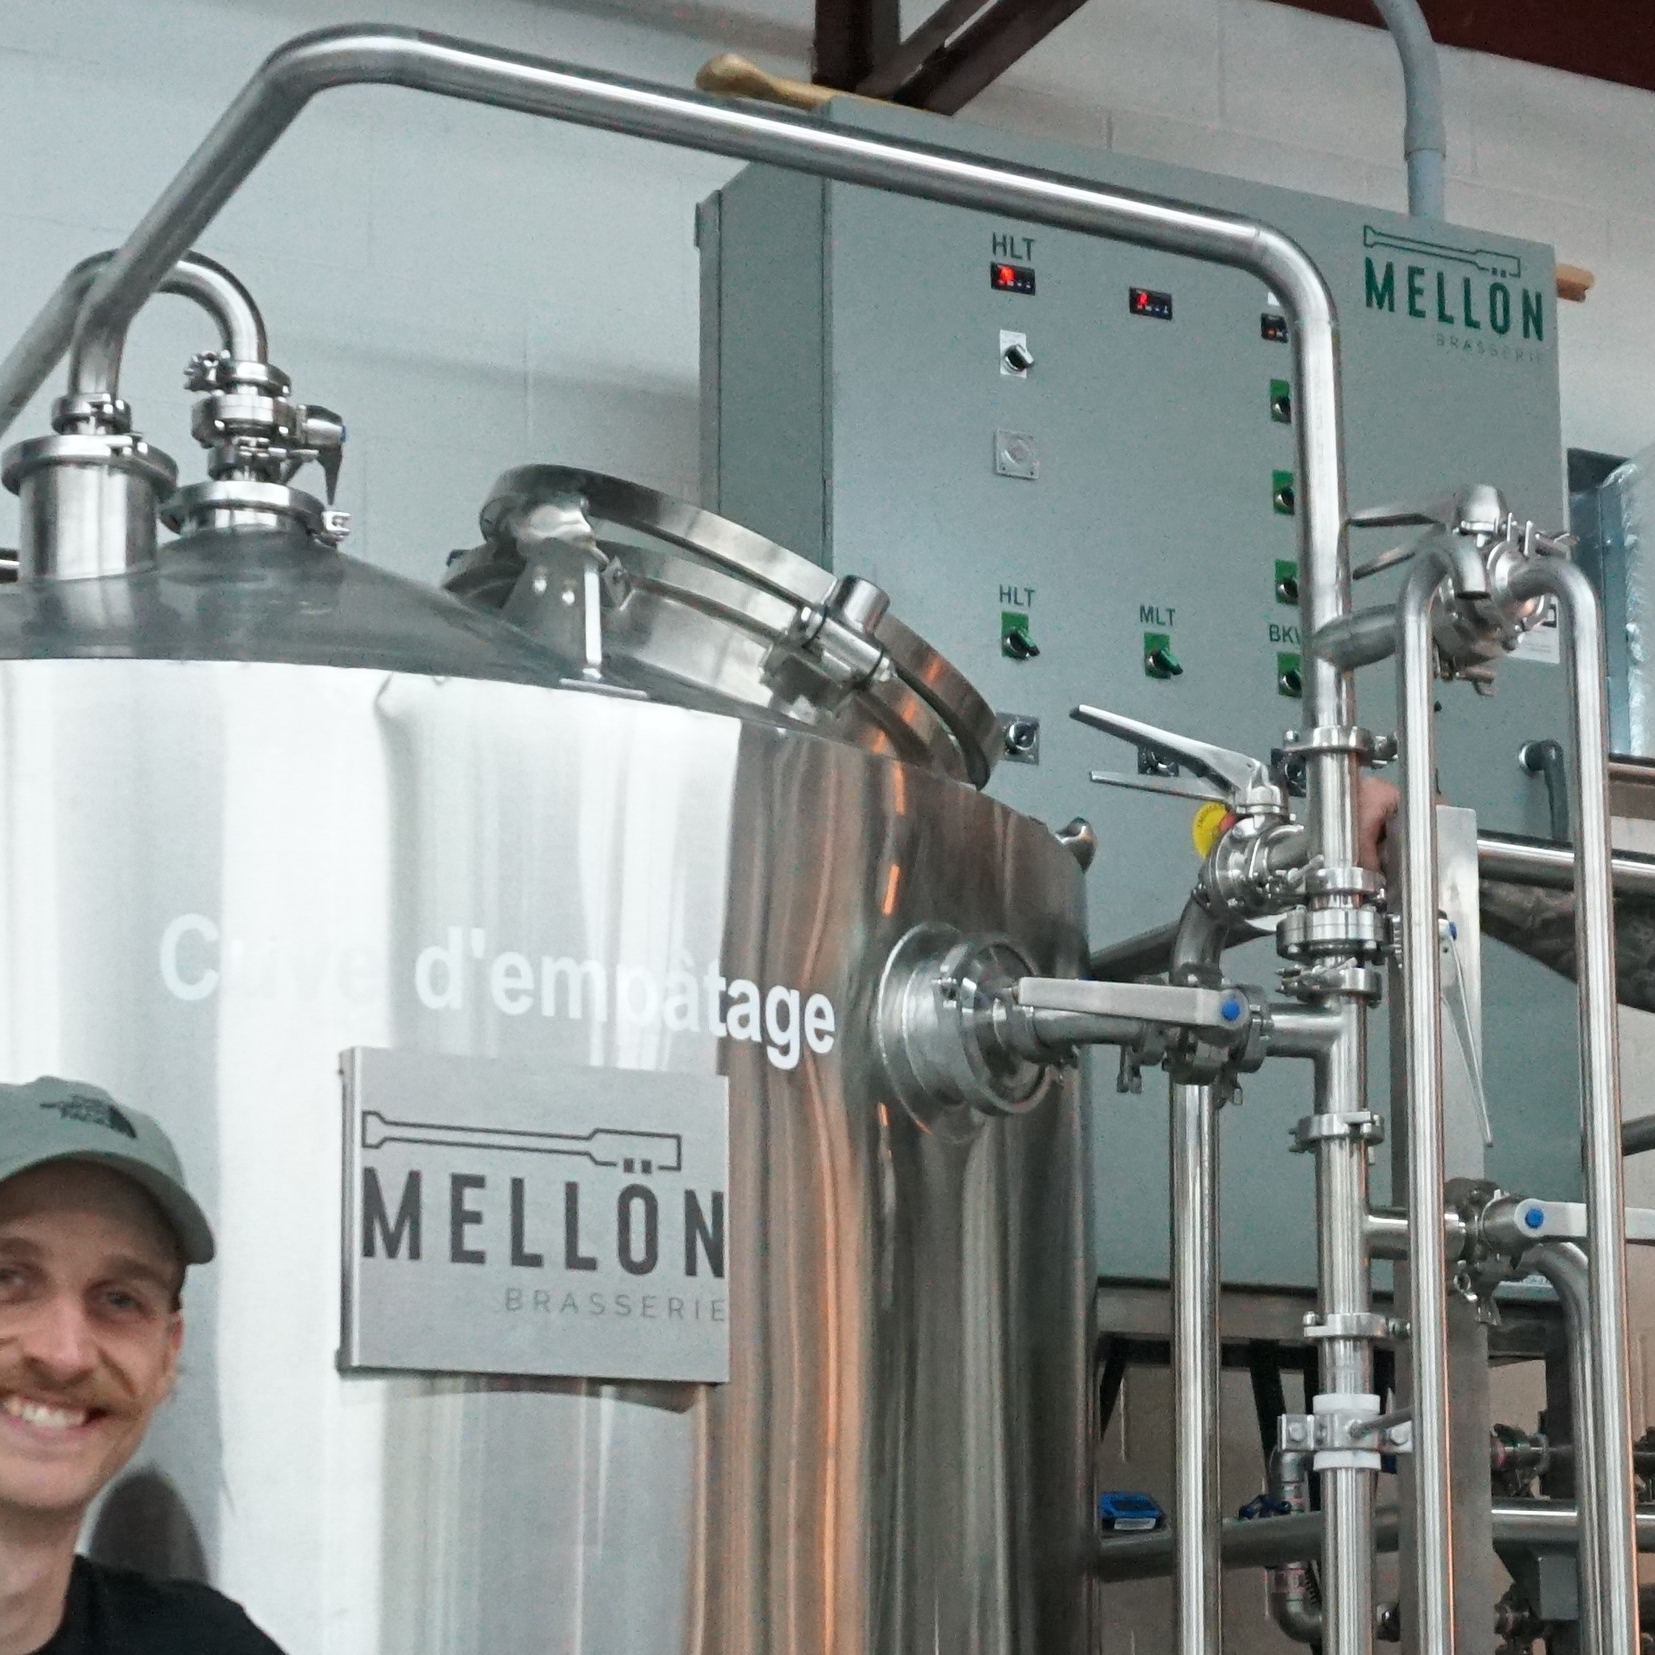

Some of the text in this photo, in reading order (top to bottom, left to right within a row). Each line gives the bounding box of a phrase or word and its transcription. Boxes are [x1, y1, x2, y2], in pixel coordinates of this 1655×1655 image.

[992, 232, 1035, 261] HLT
[1364, 256, 1544, 341] MELLÖN
[998, 584, 1035, 607] HLT
[1139, 604, 1175, 626] MLT
[414, 926, 836, 1070] d'empâtage
[362, 1157, 725, 1279] MELLÖN
[505, 1286, 726, 1322] BRASSERIE
